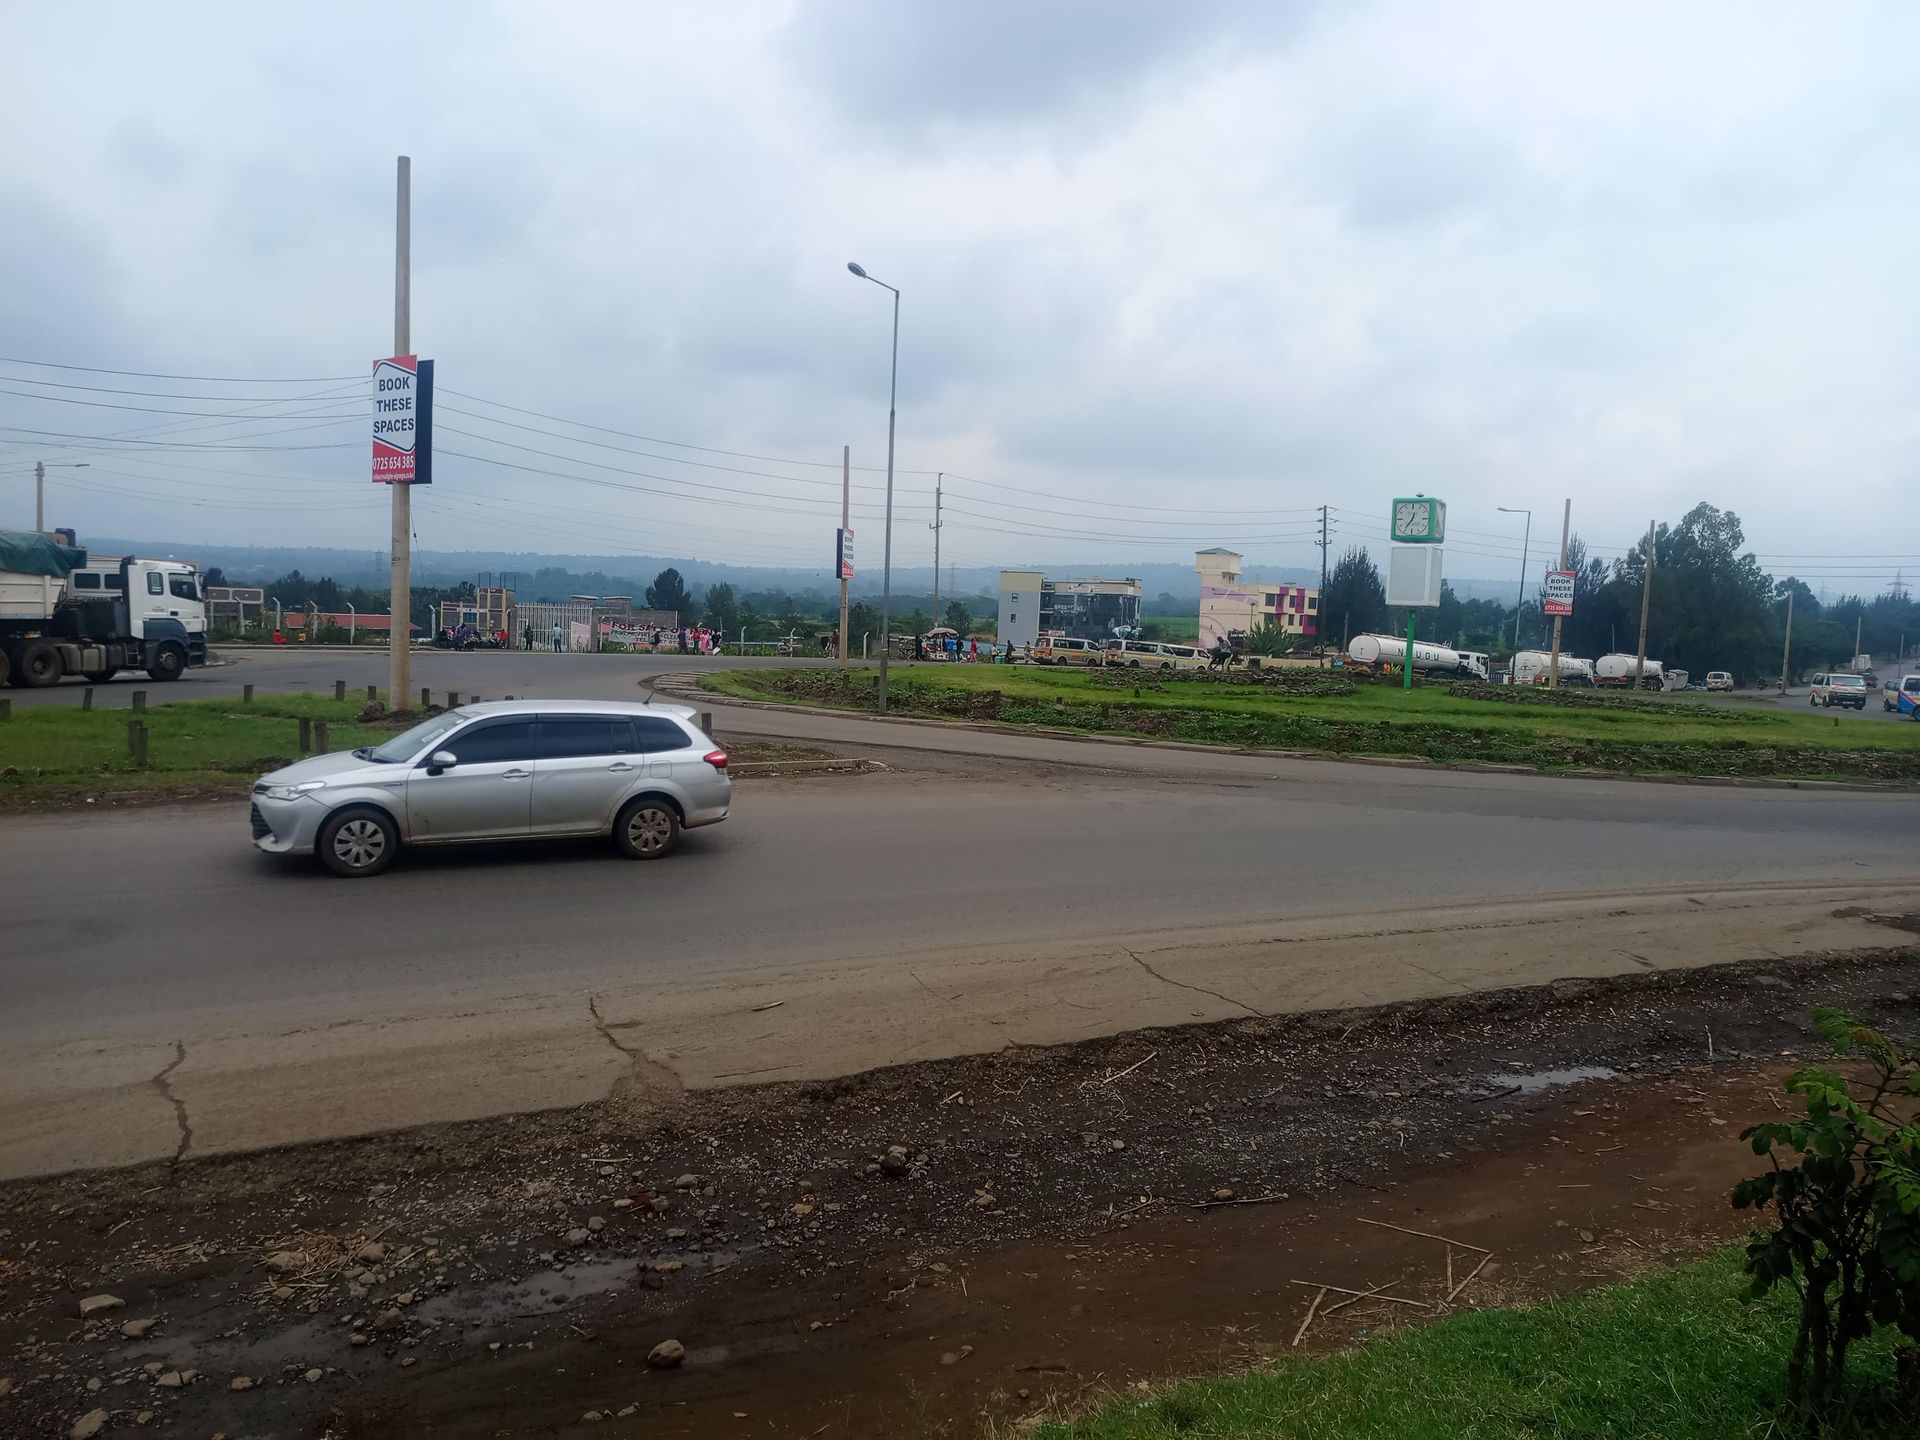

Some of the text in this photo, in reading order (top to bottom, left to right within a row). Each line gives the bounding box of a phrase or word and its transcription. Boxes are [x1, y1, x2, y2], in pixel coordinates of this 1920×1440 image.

[379, 376, 410, 391] BOOK
[376, 397, 412, 412] THESE
[373, 418, 414, 433] SPACES
[373, 455, 414, 470] 0725 654 385
[1398, 648, 1439, 660] NUGU
